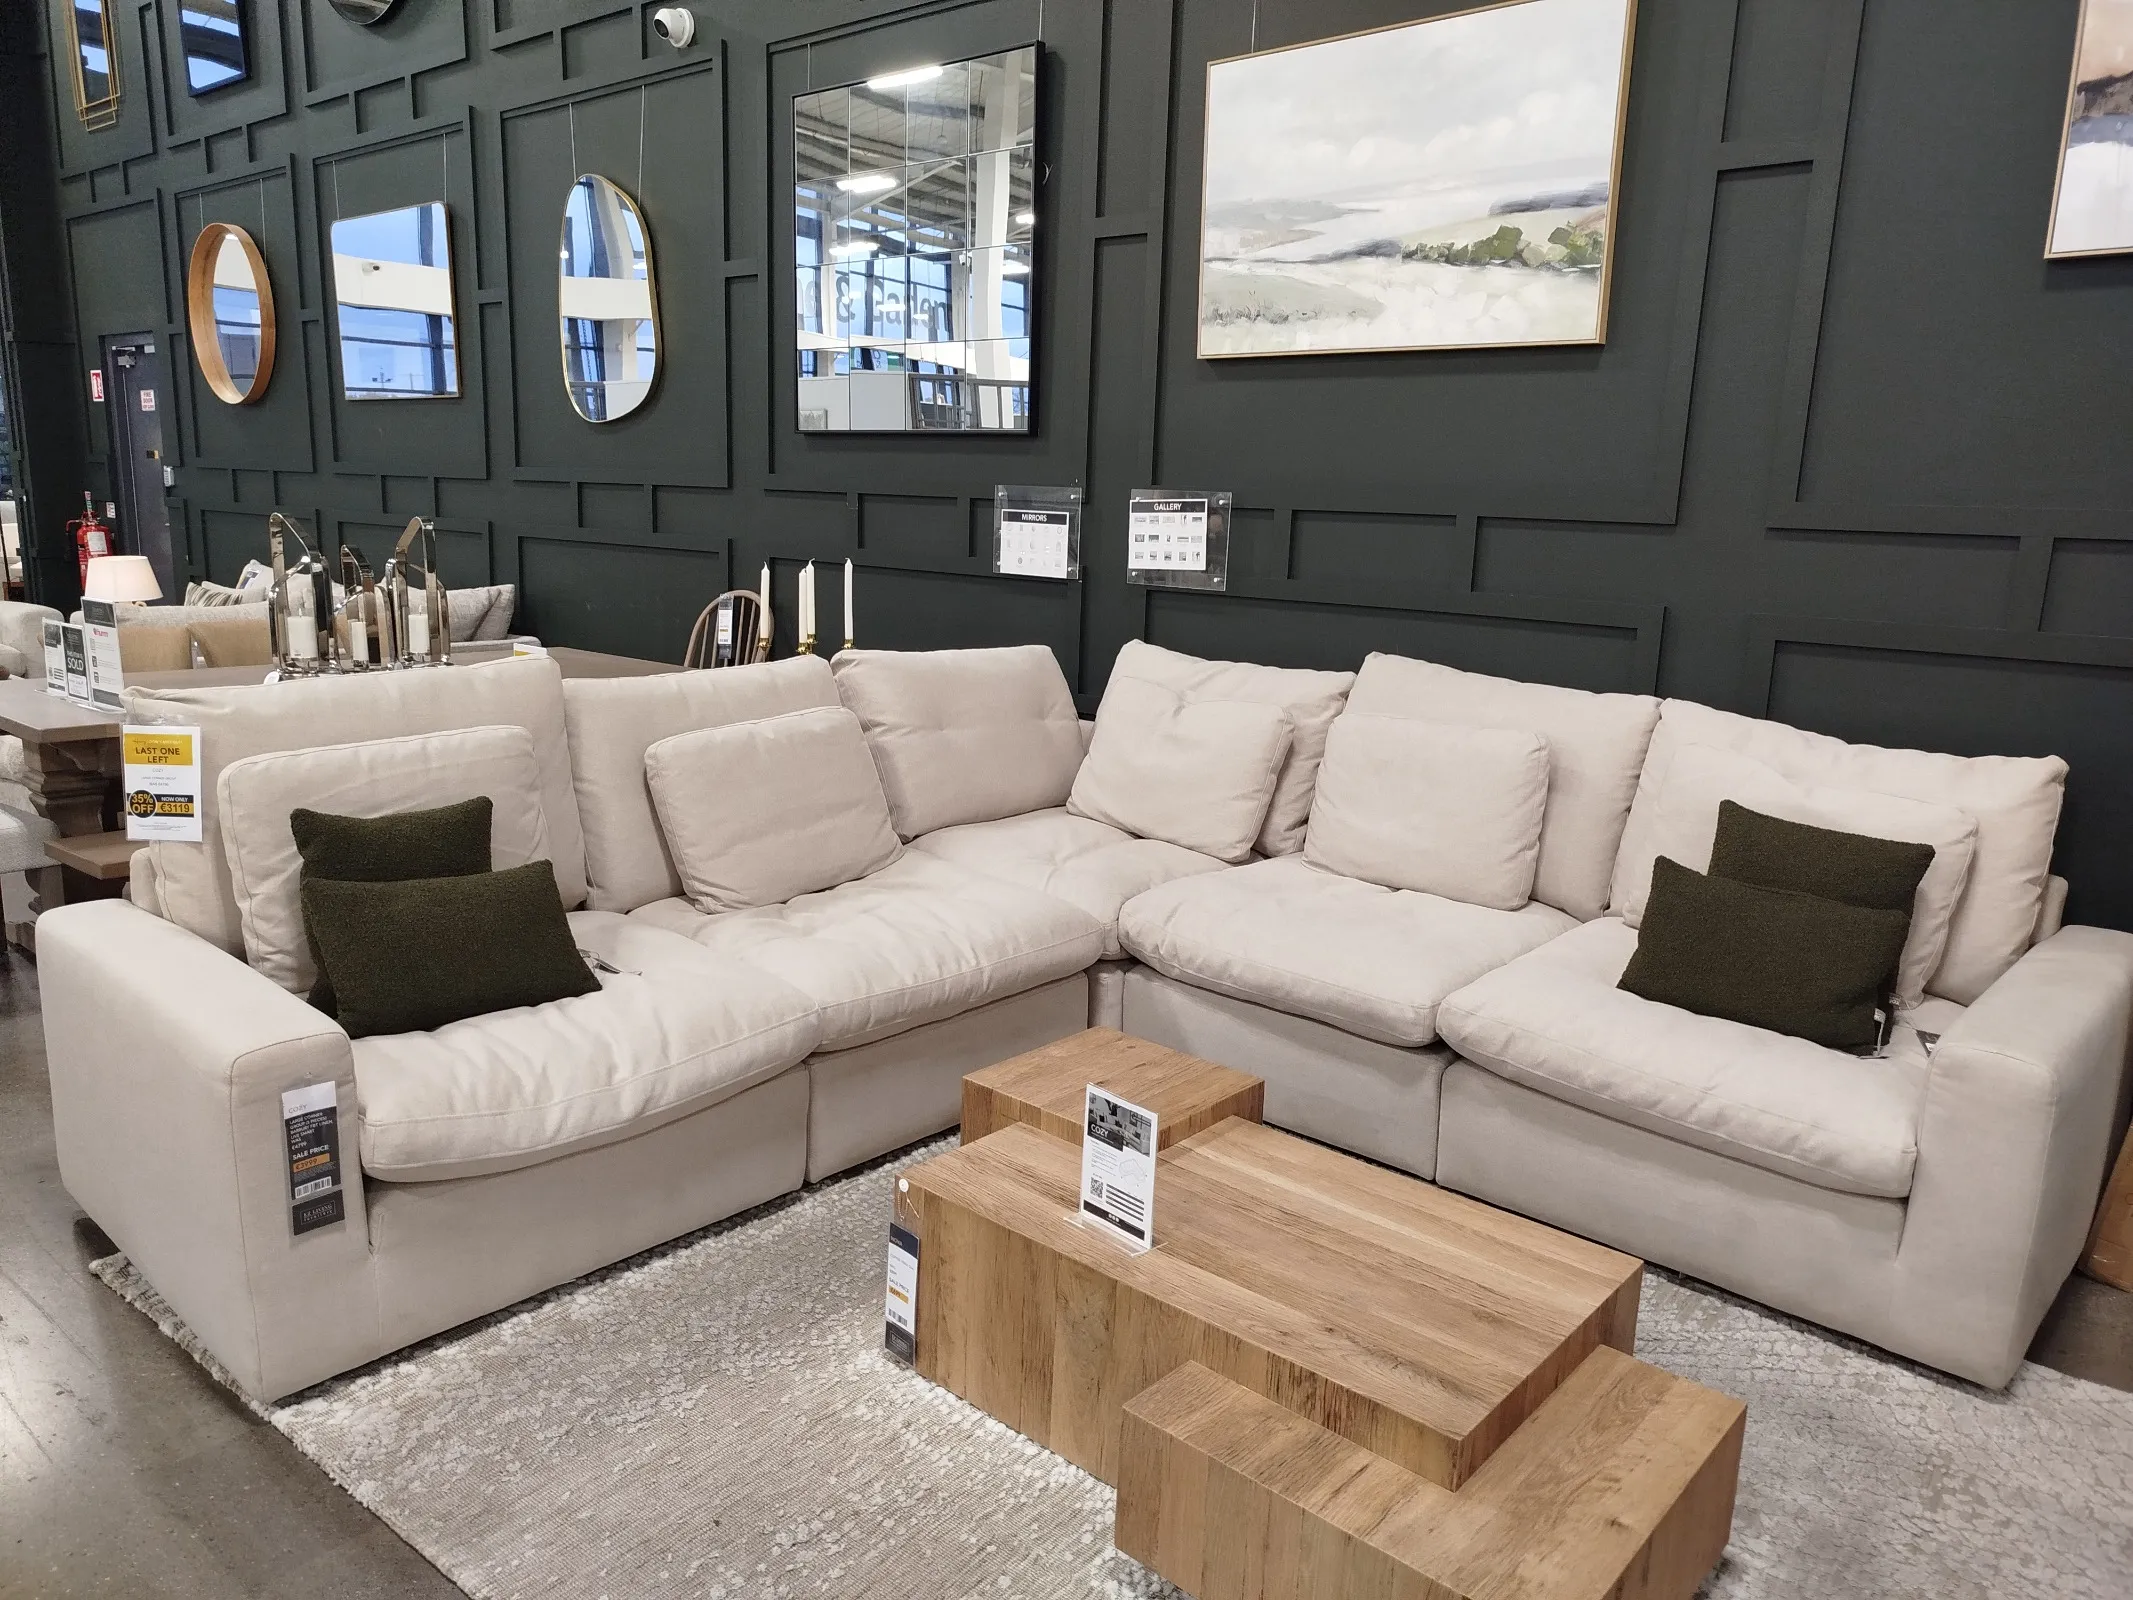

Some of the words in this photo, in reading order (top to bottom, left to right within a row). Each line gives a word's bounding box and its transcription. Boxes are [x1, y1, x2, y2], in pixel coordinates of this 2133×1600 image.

[1153, 502, 1182, 512] GALLERY
[1021, 513, 1048, 523] MIRRORS
[67, 657, 84, 671] SOLD
[135, 746, 157, 755] LAST
[160, 747, 180, 756] ONE
[147, 755, 169, 764] LEFT
[132, 793, 154, 804] 35%
[132, 804, 154, 814] OFF
[160, 803, 190, 813] €3119
[288, 1104, 308, 1114] COZY
[1090, 1123, 1109, 1139] COZY
[292, 1151, 309, 1161] SALE
[309, 1144, 330, 1155] PRICE
